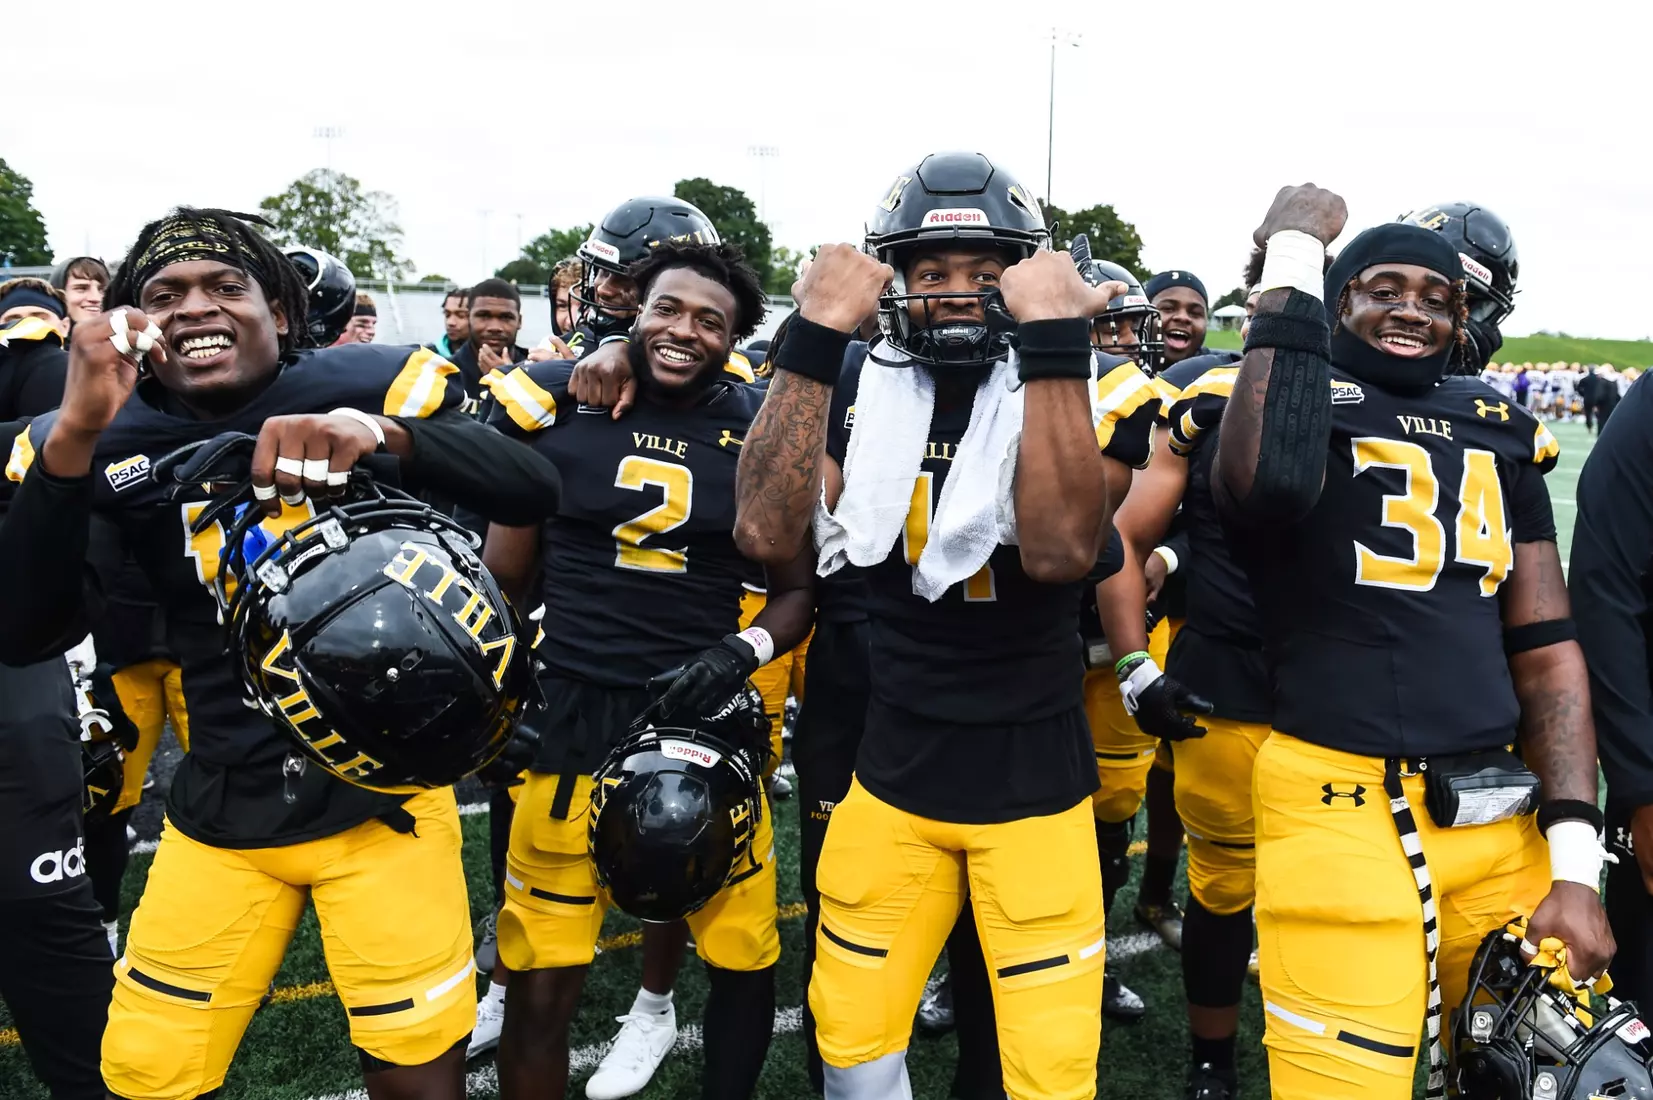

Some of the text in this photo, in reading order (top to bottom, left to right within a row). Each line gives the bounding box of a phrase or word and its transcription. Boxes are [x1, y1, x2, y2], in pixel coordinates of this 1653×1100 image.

[930, 212, 981, 223] Riddell
[1331, 387, 1362, 397] PSAC
[1397, 415, 1453, 441] VILLE
[632, 431, 689, 459] VILLE
[109, 460, 149, 484] PSAC
[612, 454, 693, 573] 2
[1350, 436, 1514, 598] 34
[383, 540, 518, 692] VILLE
[261, 627, 385, 780] VILLE
